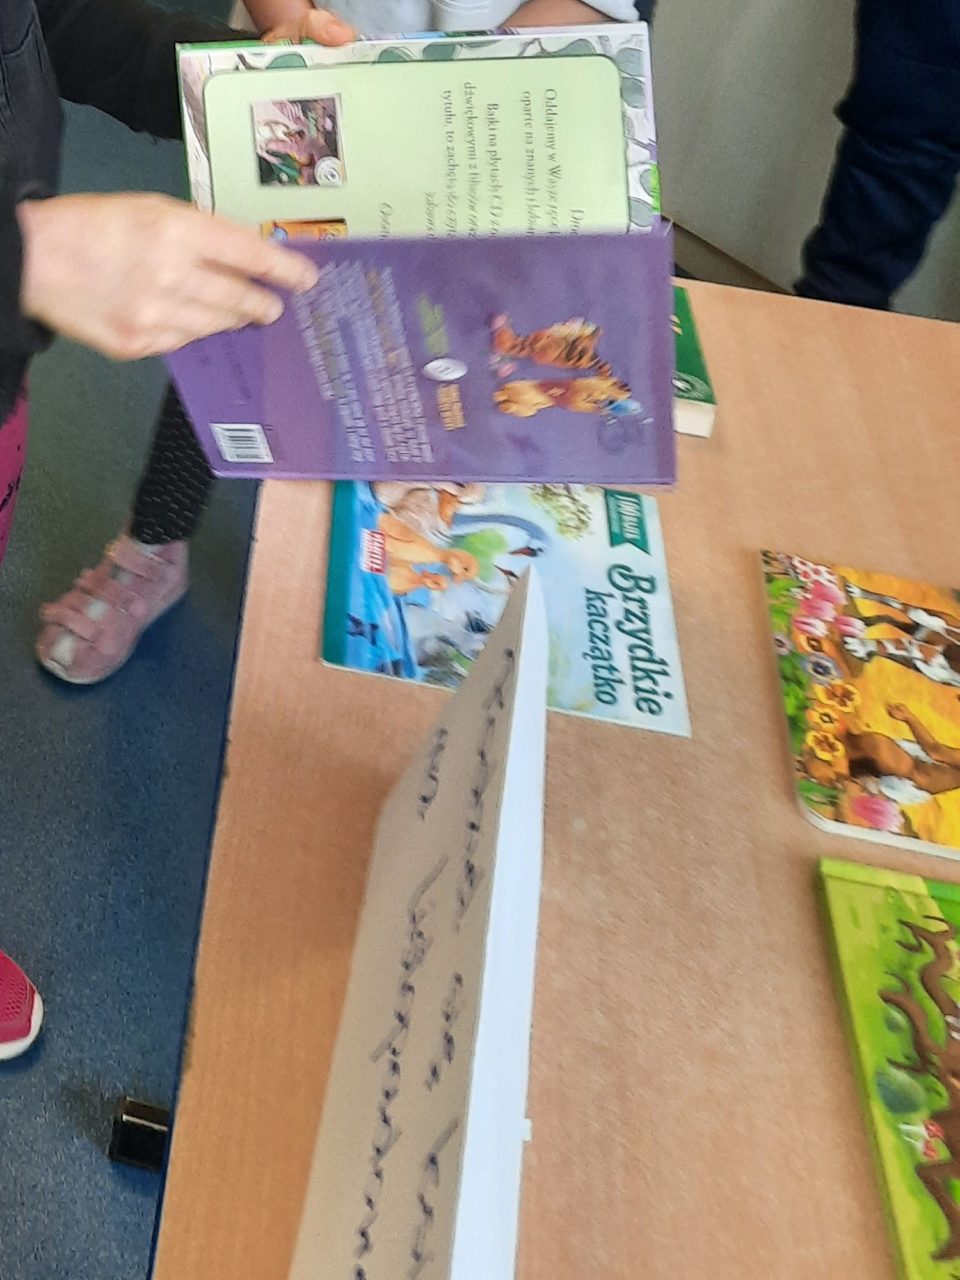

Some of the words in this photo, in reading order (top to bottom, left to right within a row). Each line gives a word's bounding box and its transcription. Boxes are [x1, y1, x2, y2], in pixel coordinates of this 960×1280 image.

[463, 82, 480, 160] dźwiękowymi
[485, 103, 501, 130] Bajki
[519, 91, 535, 129] oparte
[543, 88, 560, 150] Oddajemy
[446, 131, 456, 143] to
[488, 134, 498, 147] na
[525, 132, 535, 145] na
[522, 148, 541, 195] znanych
[547, 153, 557, 163] w
[583, 587, 627, 705] kaczątko
[608, 564, 674, 715] Brzydkie
